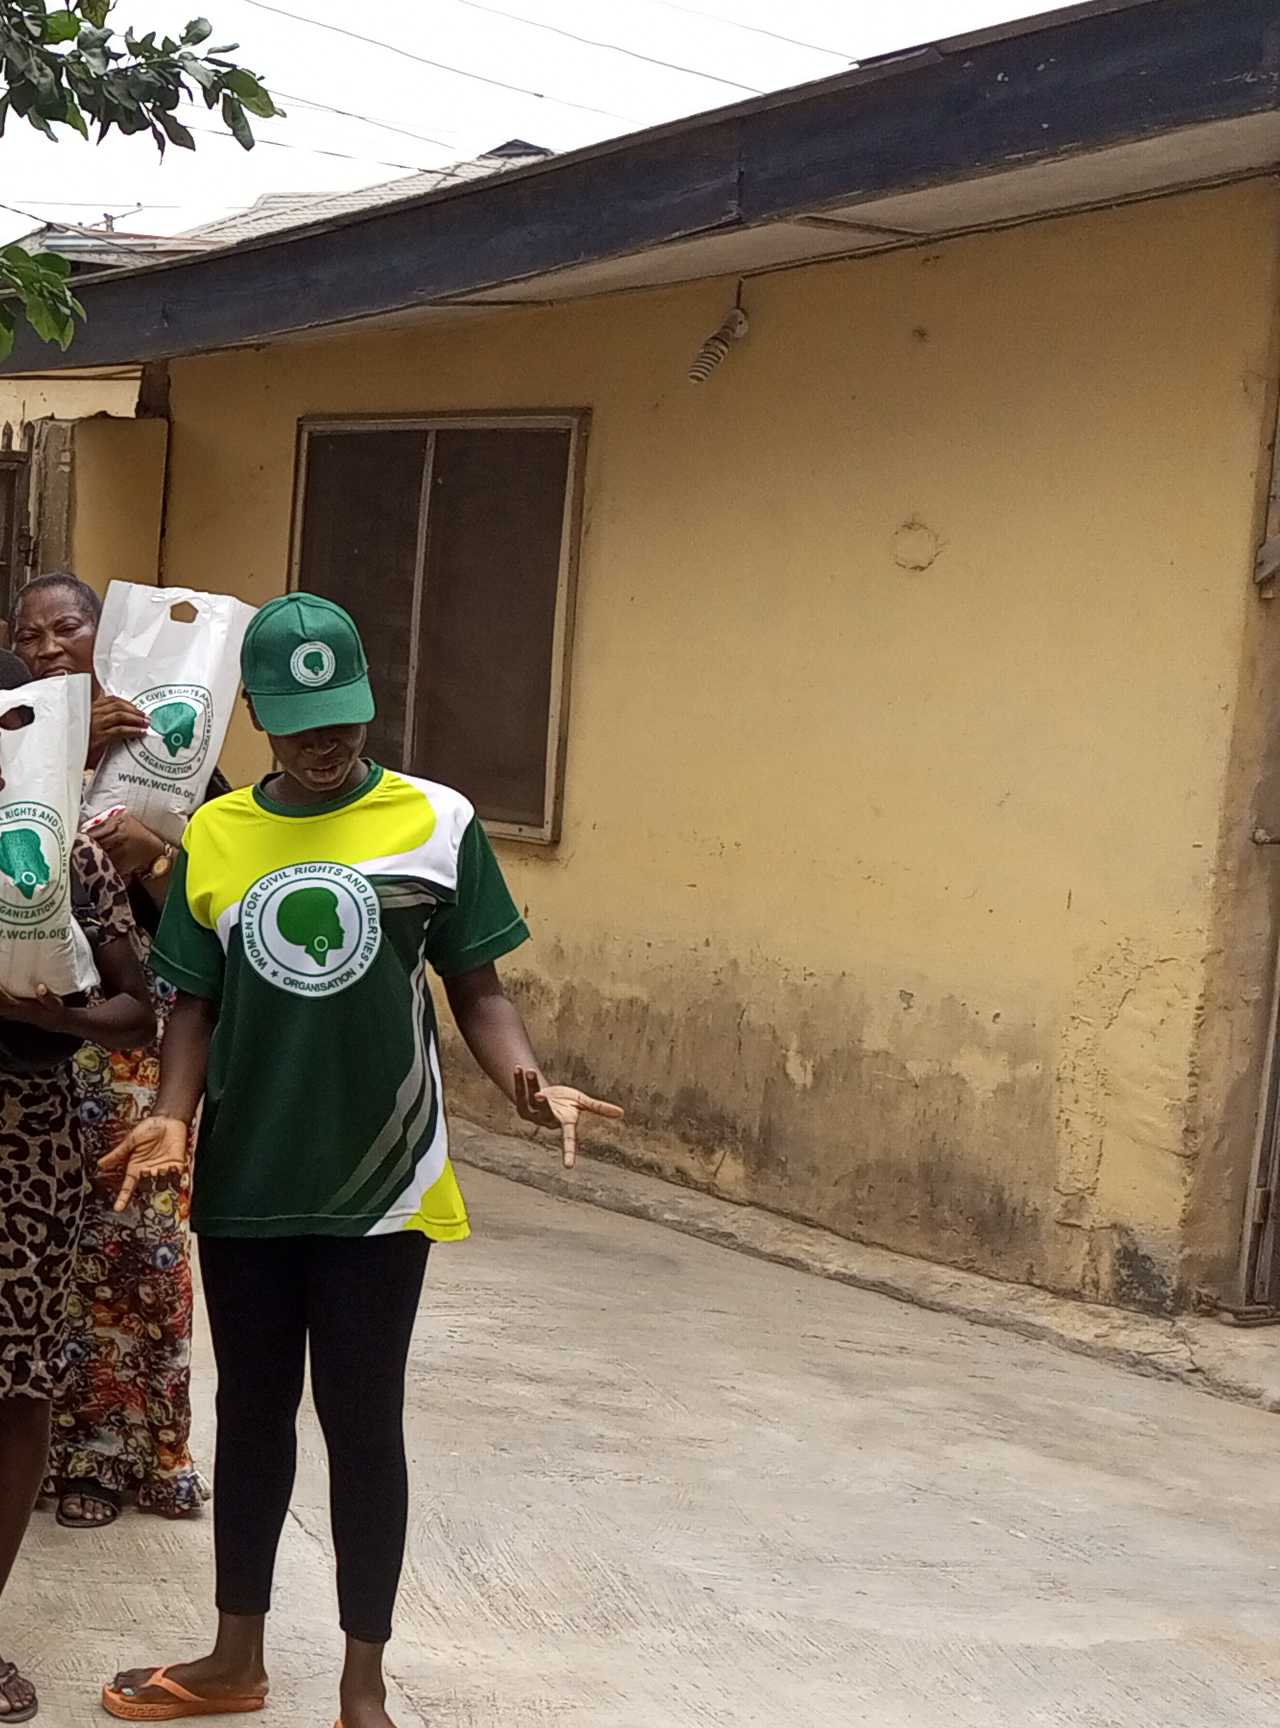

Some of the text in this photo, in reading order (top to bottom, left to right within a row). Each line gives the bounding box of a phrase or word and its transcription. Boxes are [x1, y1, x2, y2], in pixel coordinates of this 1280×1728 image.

[146, 690, 167, 702] CIVIL
[139, 751, 192, 775] ORGANIZATION
[5, 808, 37, 819] RIGHTS
[39, 811, 58, 827] AND
[245, 865, 378, 970] WOMEN FOR CIVIL RIGHTS AND LIBERTIES
[283, 968, 357, 992] ORGANISATION
